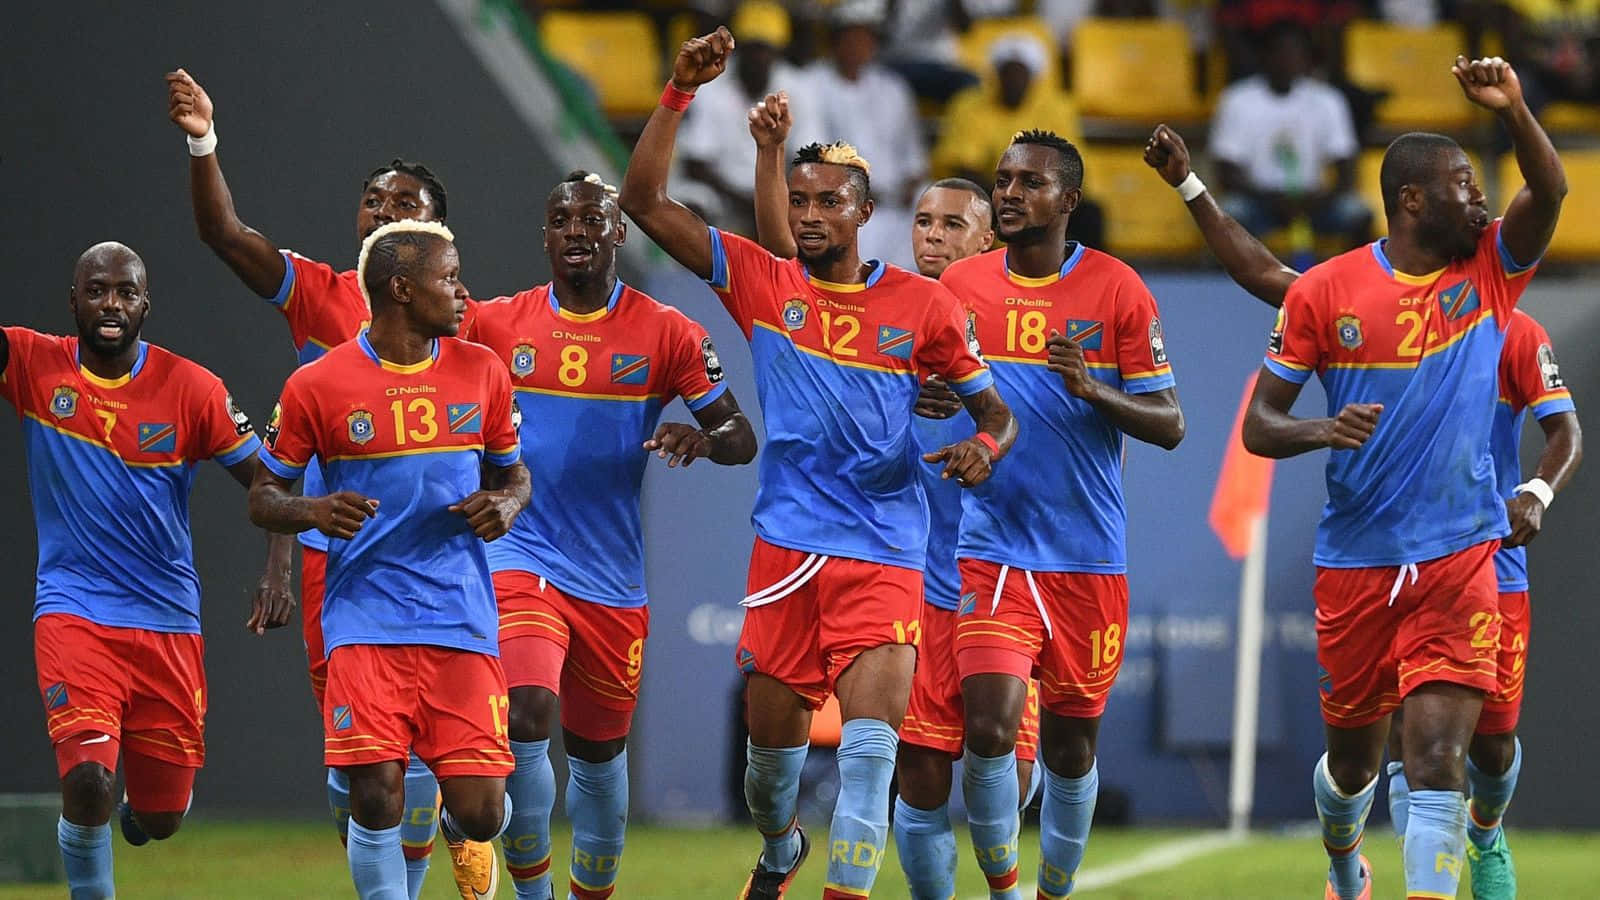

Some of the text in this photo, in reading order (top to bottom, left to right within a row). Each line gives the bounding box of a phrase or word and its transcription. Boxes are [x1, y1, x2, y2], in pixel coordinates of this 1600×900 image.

[820, 311, 861, 357] 12
[1006, 309, 1047, 354] 18
[558, 345, 589, 387] 8
[95, 409, 117, 443] 7
[391, 398, 438, 446] 13
[1089, 623, 1120, 668] 18
